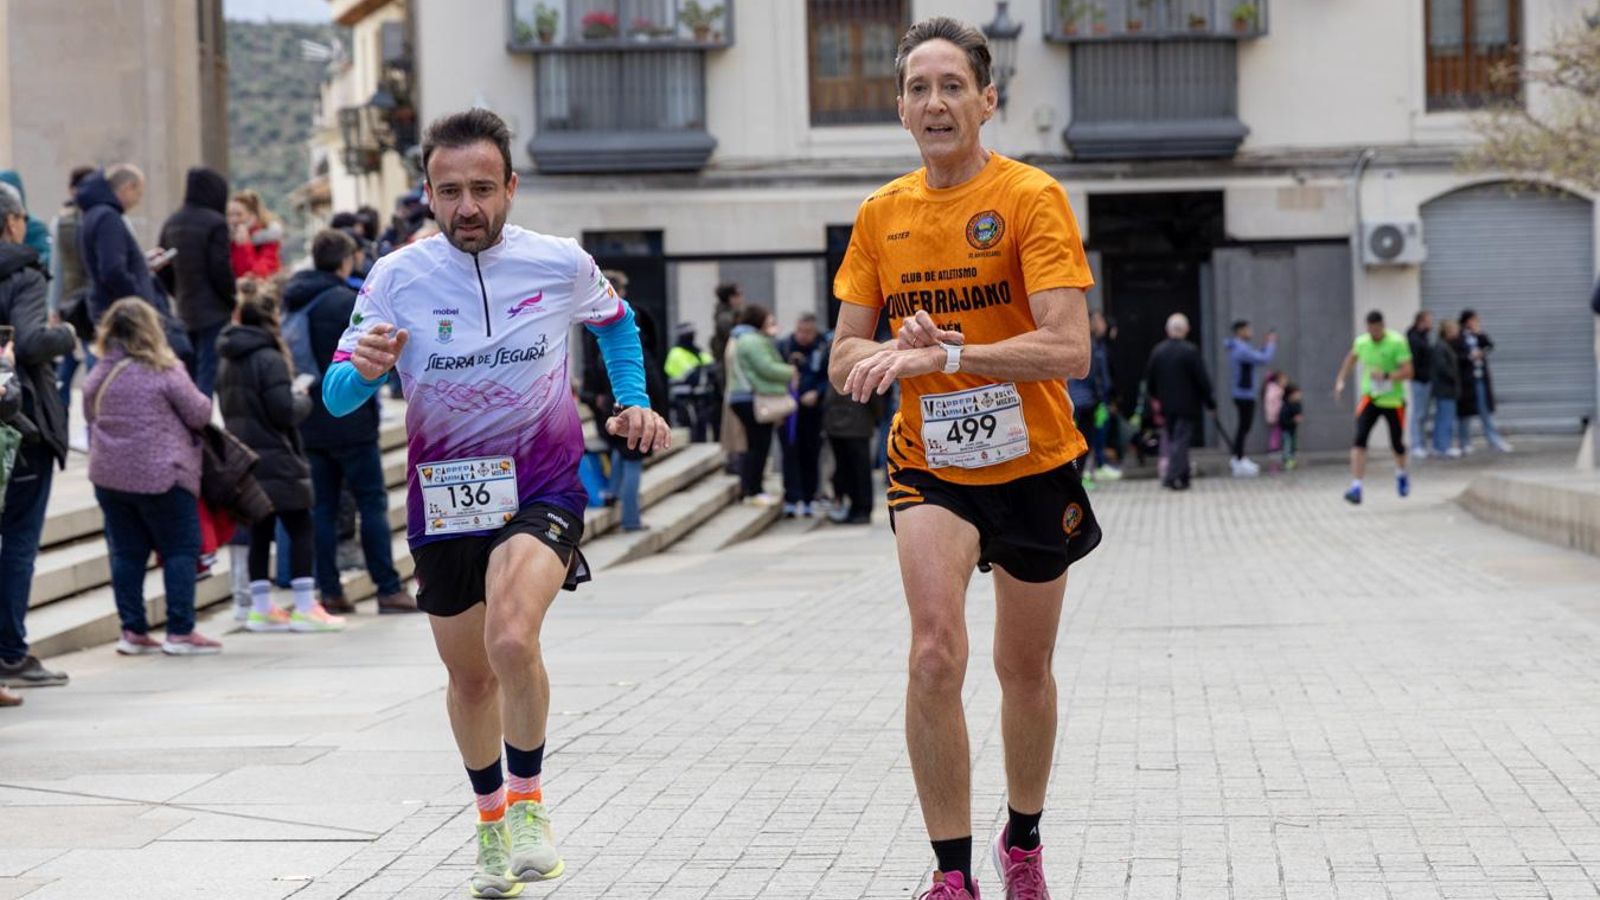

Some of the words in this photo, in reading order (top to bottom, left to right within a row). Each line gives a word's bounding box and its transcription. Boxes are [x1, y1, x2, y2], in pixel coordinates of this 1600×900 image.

[887, 231, 910, 240] FASTER
[901, 272, 921, 284] CLUB
[925, 271, 935, 282] DE
[938, 267, 977, 280] ATLETISMO
[886, 280, 1011, 320] QUIEBRAJANO
[424, 352, 475, 372] SIERRA
[477, 354, 492, 365] DE
[489, 346, 545, 369] SEGURA
[946, 414, 997, 444] 499
[447, 482, 491, 508] 136
